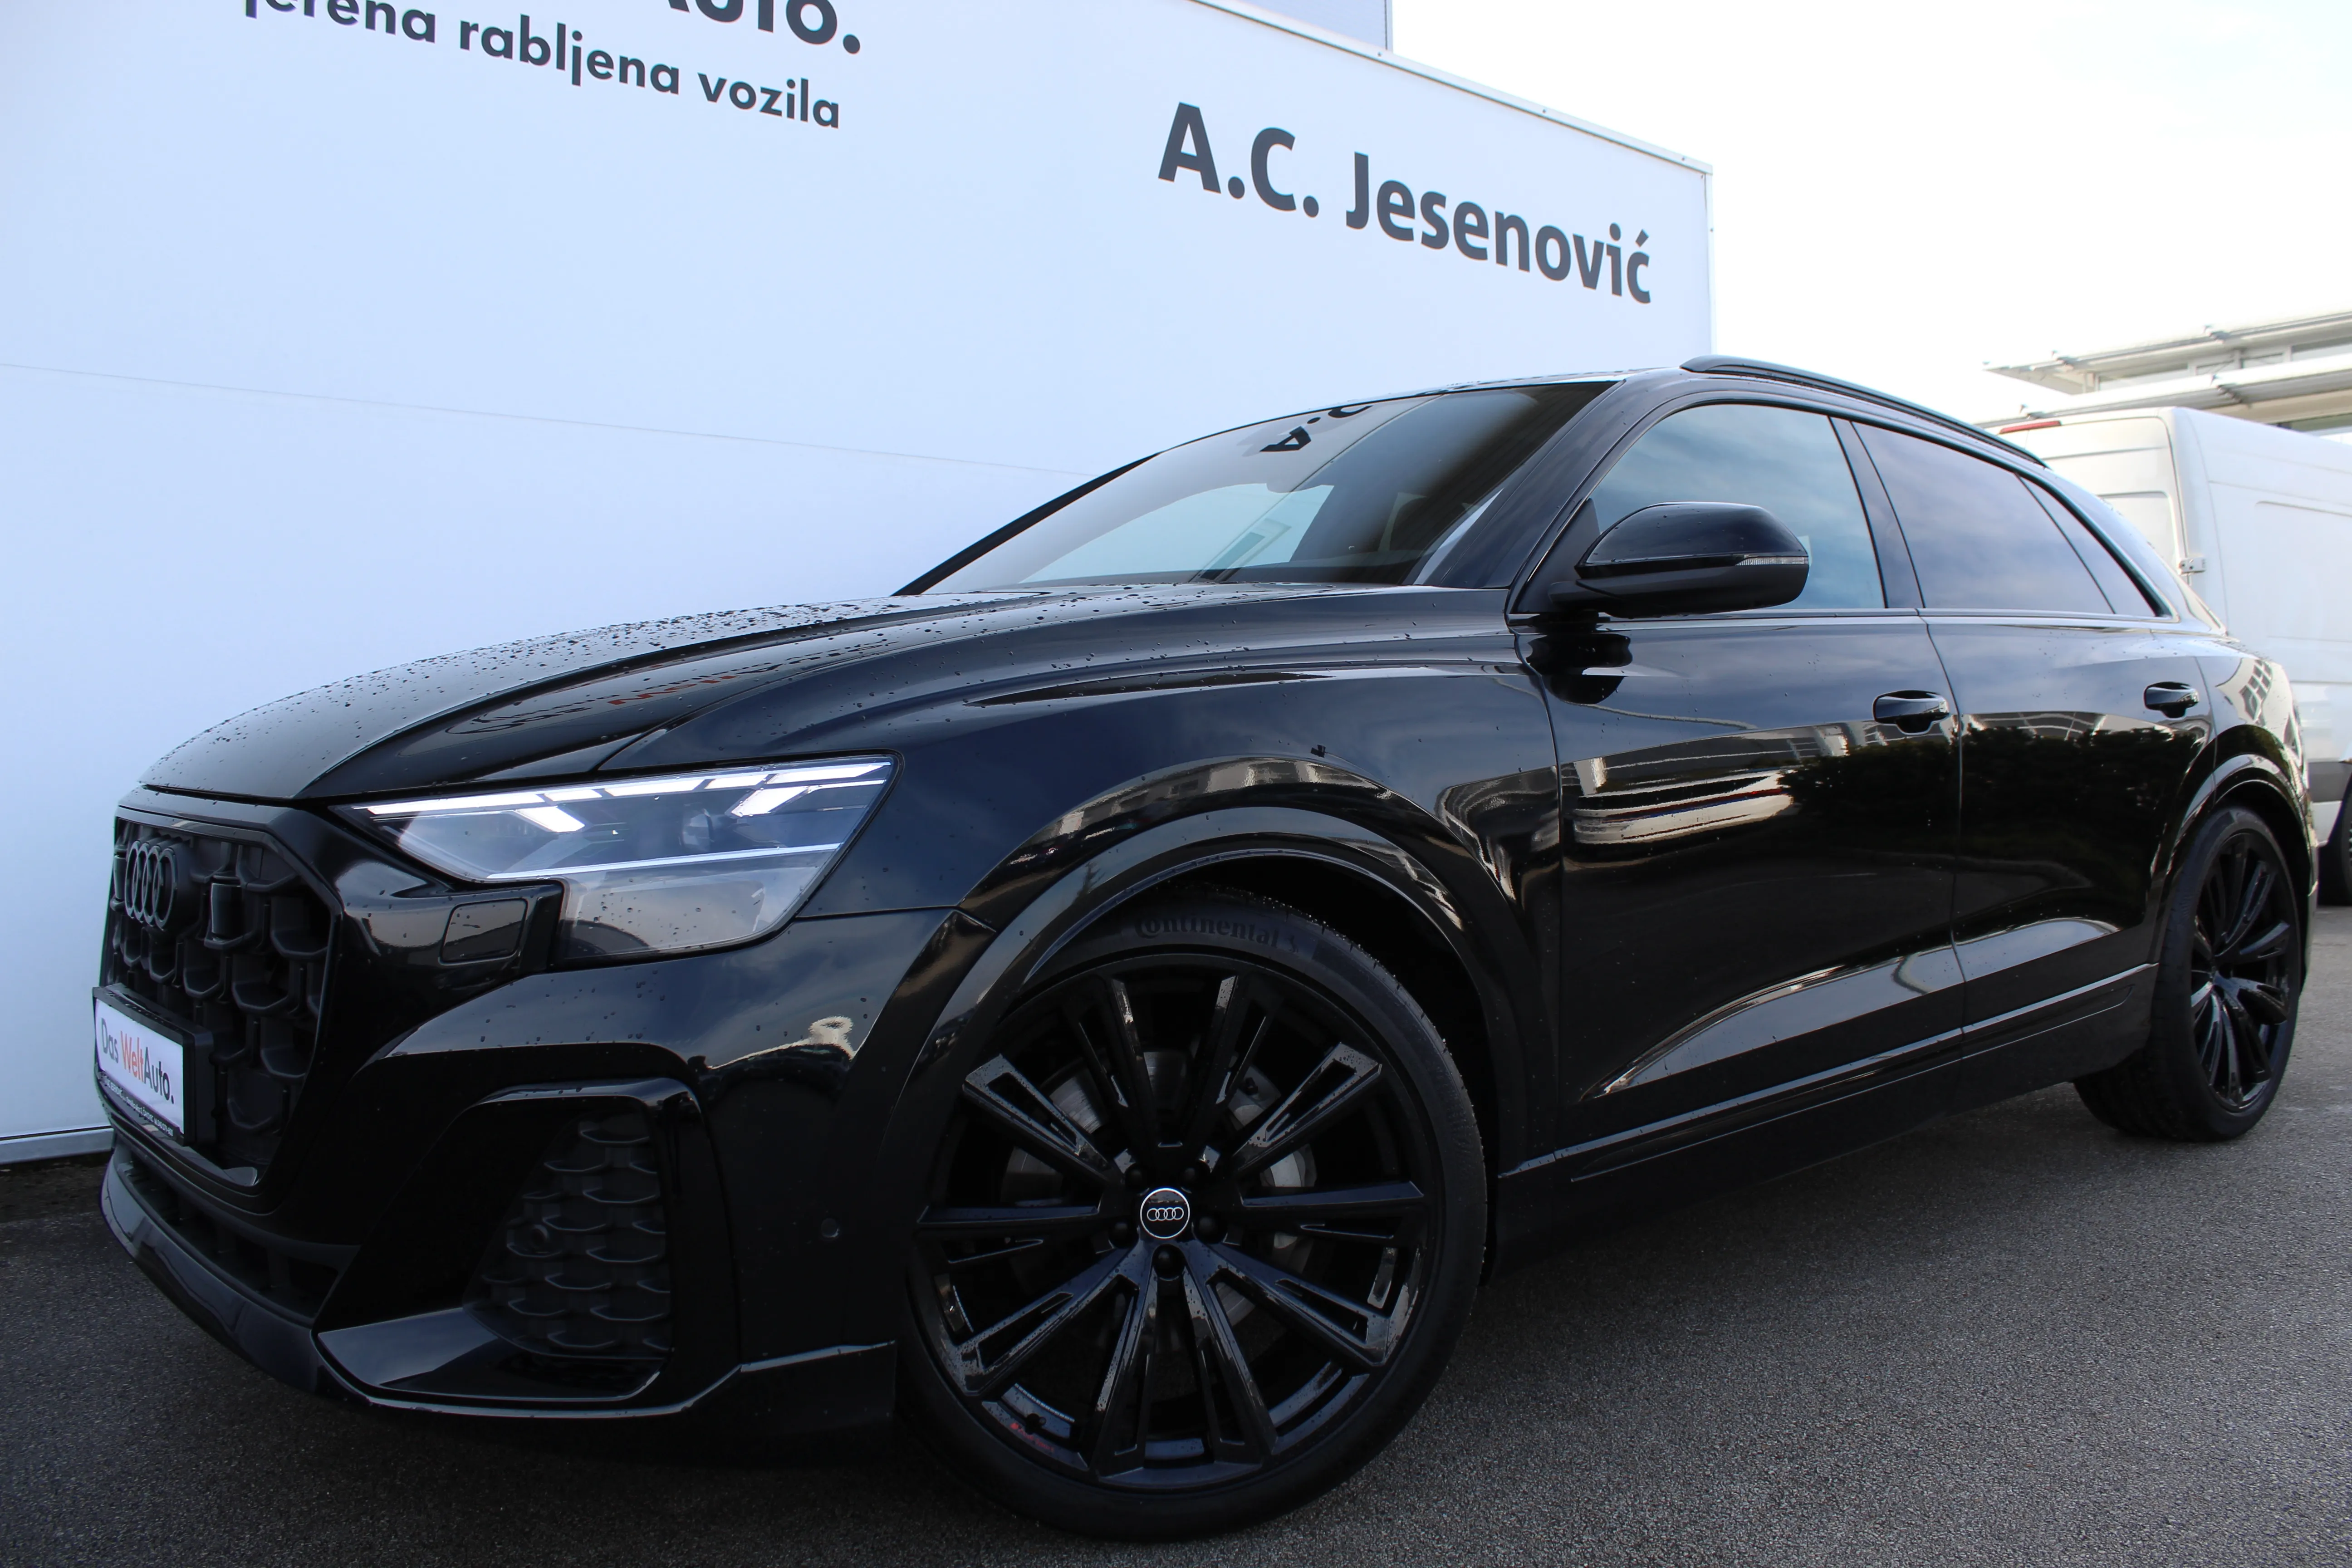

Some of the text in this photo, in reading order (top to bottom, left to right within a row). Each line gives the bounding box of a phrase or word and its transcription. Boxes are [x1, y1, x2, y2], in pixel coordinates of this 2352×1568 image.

[460, 14, 679, 95] rabljena
[697, 78, 839, 129] vozila
[1158, 102, 1651, 304] A.C. Jesenović
[1134, 913, 1279, 948] Continental
[101, 1018, 174, 1105] Das WeltAuto.
